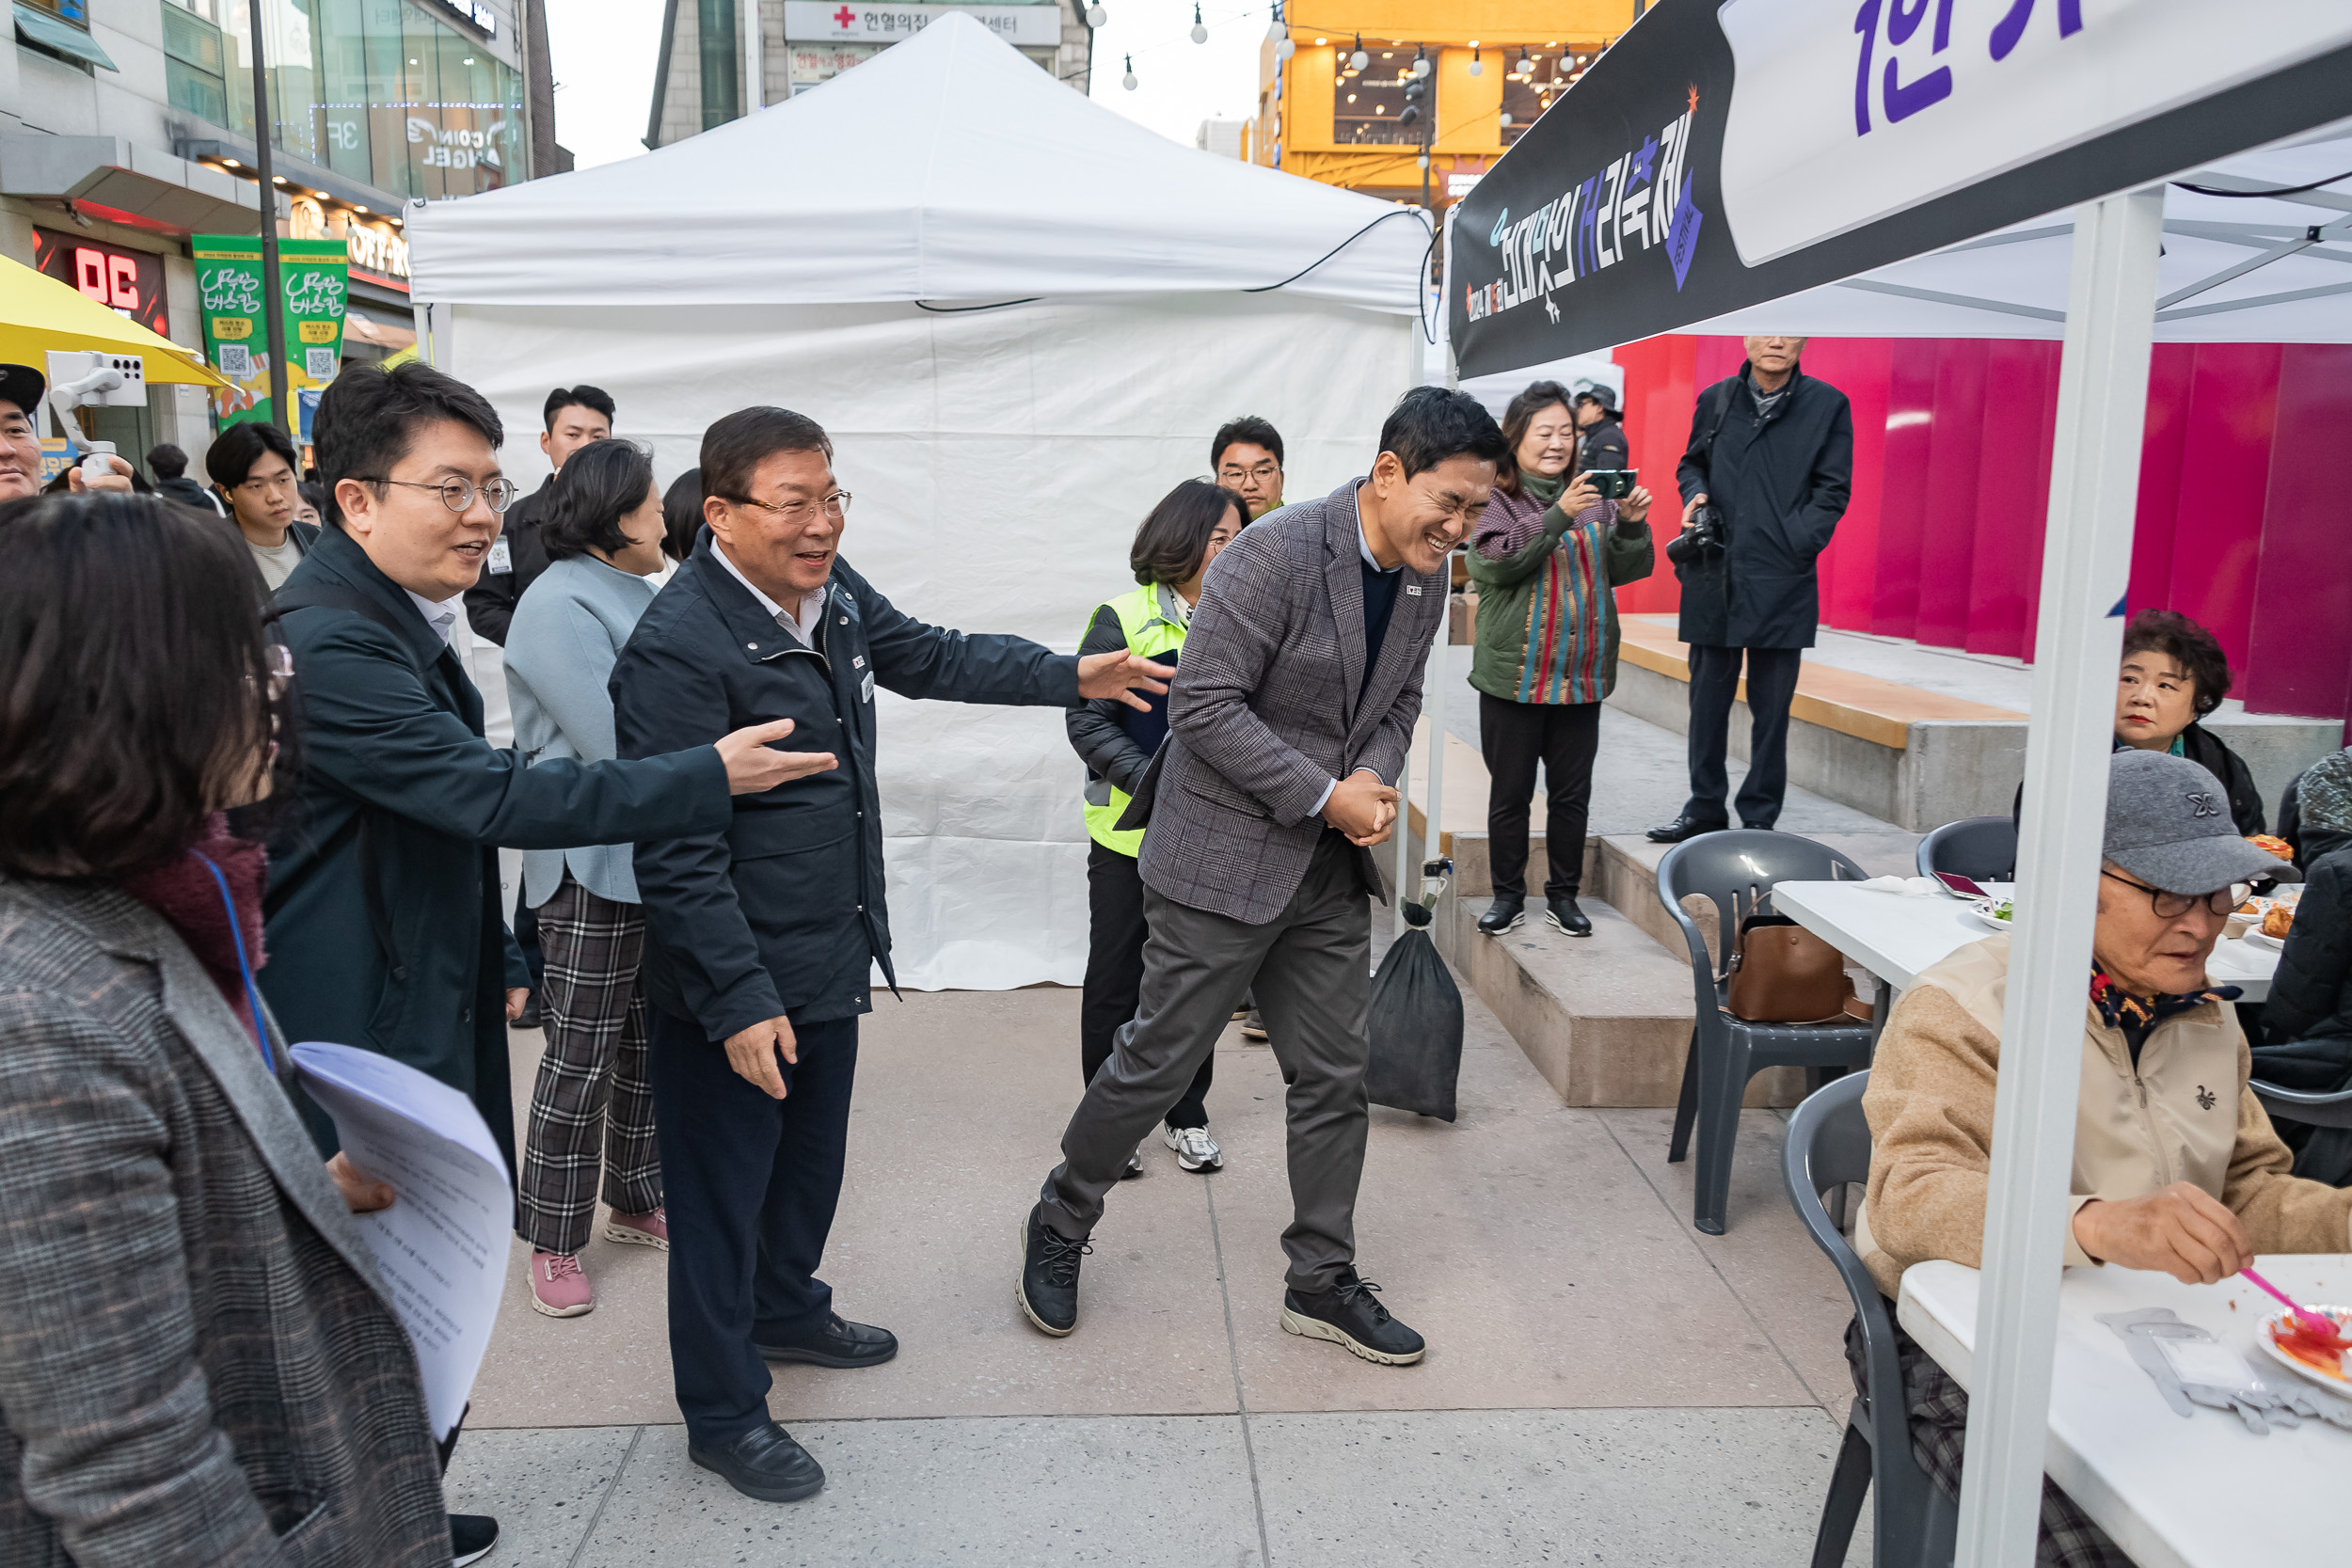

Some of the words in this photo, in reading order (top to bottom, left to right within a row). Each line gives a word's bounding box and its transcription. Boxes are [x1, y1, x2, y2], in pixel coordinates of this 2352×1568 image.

[864, 11, 929, 32] 헌혈의집
[204, 291, 261, 314] 버스킹
[289, 293, 344, 318] 버스킹
